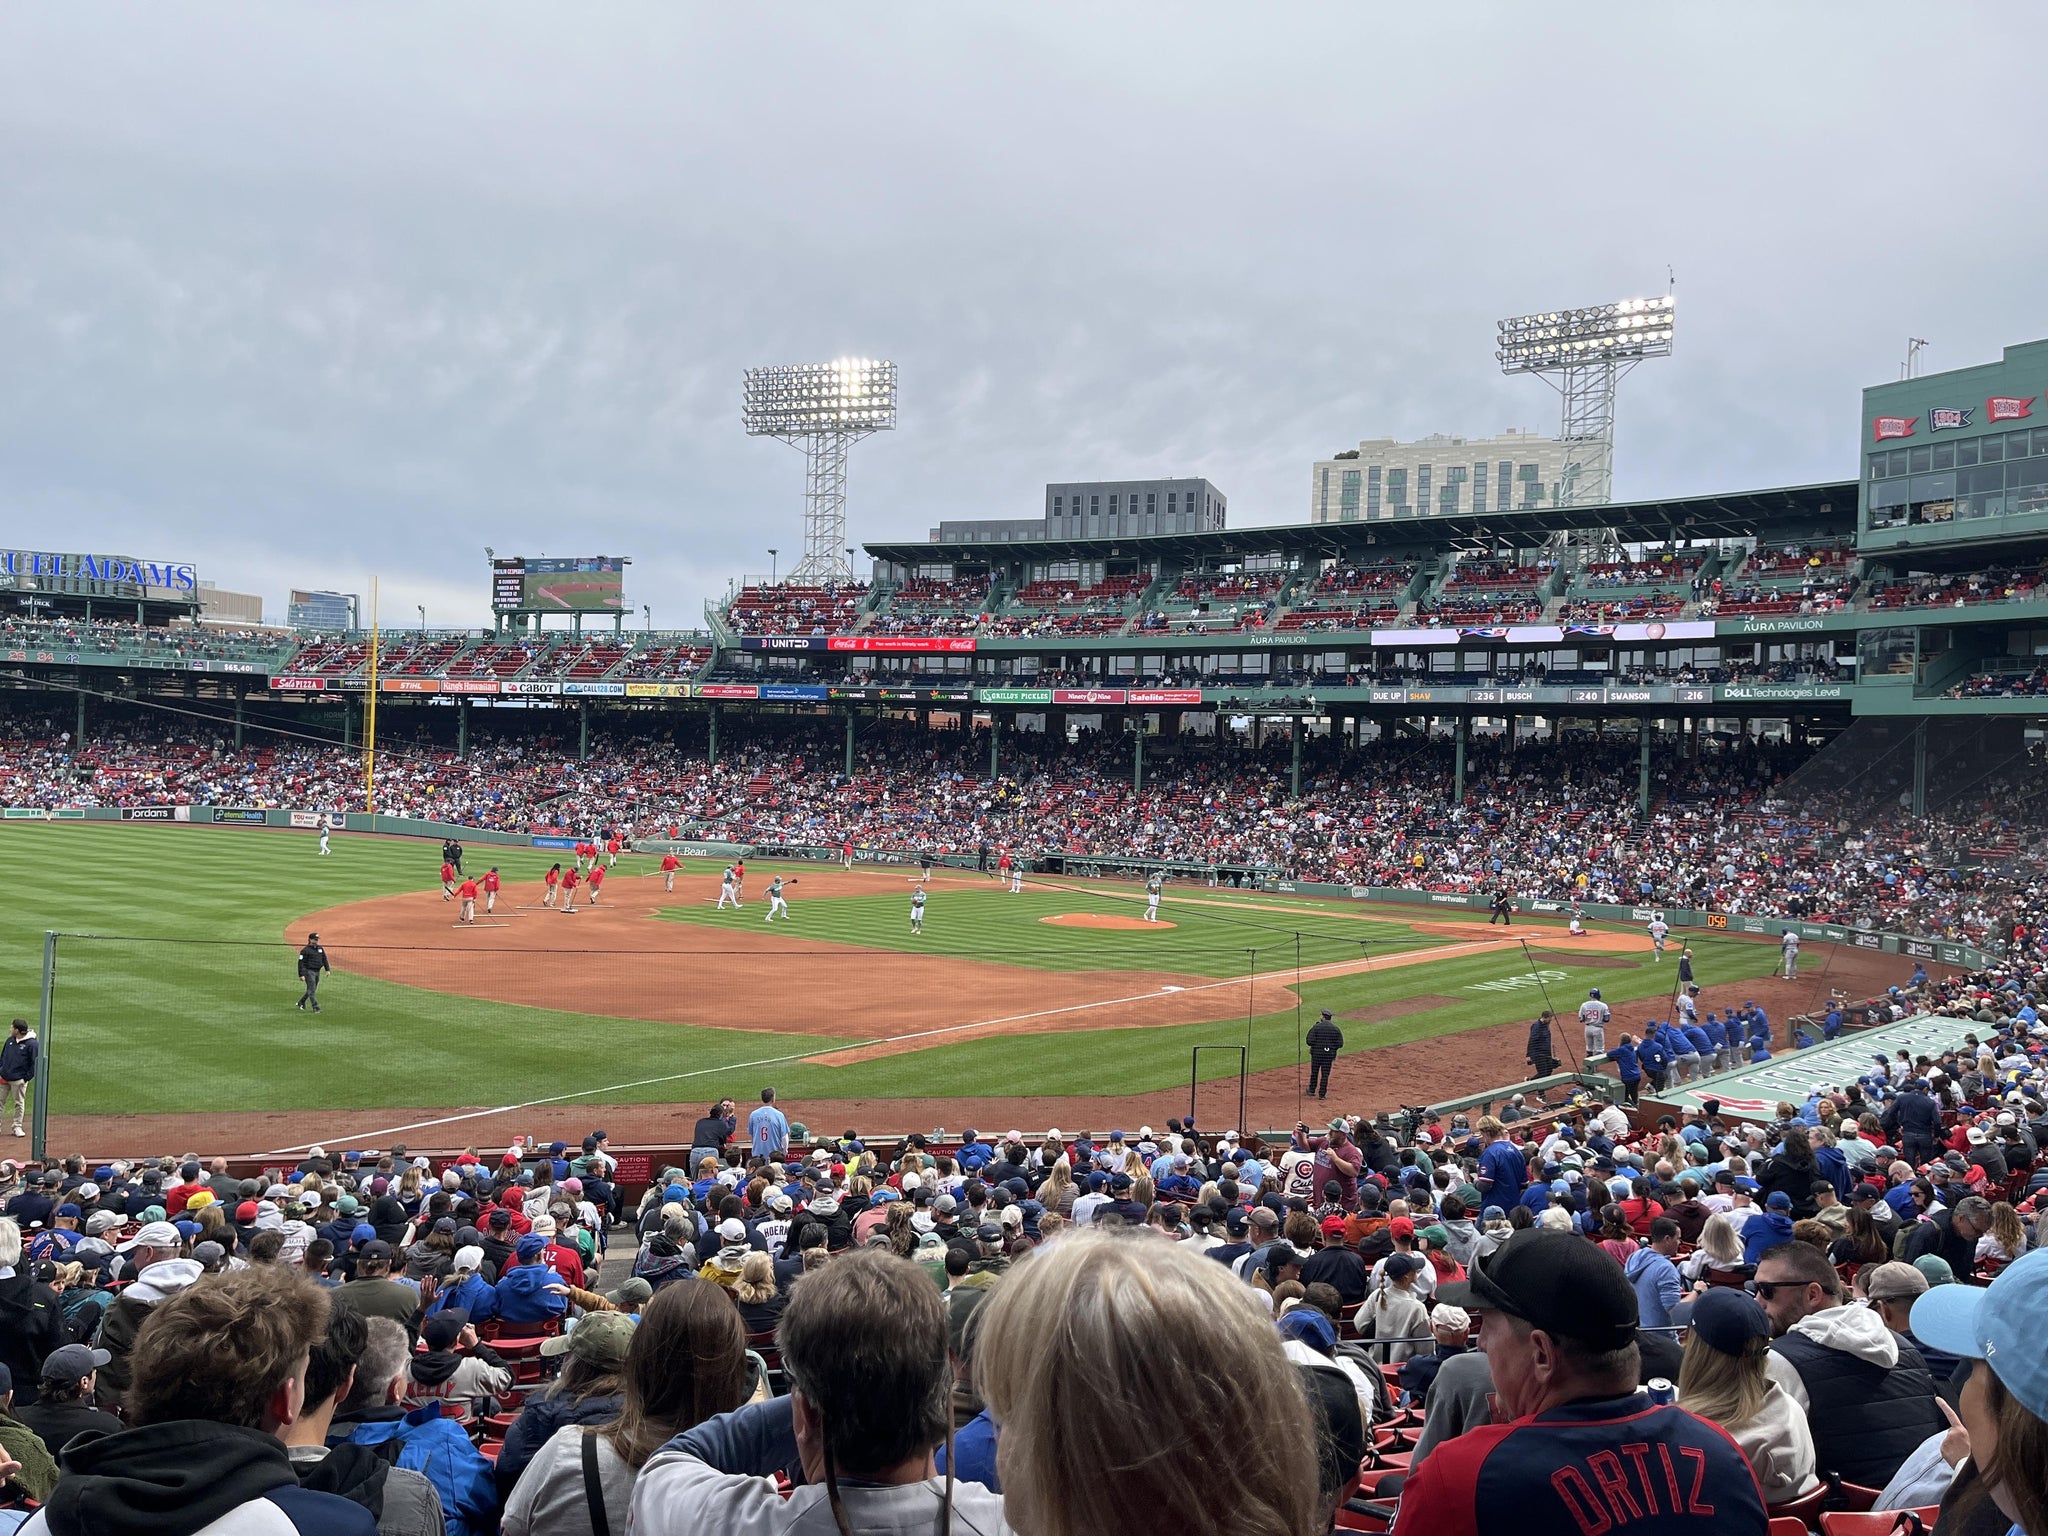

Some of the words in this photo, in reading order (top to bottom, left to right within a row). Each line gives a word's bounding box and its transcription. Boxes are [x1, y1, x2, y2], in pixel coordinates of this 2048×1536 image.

[0, 552, 71, 577] UEL
[75, 553, 194, 591] ADAMS
[1778, 620, 1823, 630] PAVILION
[772, 639, 809, 648] UNITED
[834, 639, 856, 648] Coca-Cola
[950, 640, 972, 649] Coca-Cola
[36, 652, 54, 662] 34
[65, 654, 80, 664] 42
[296, 680, 317, 689] PIZZA
[443, 682, 462, 692] King's
[464, 682, 497, 691] Hawaiian
[520, 683, 554, 693] CABOT
[583, 684, 623, 693] CALL128.COM
[1474, 692, 1494, 700] .236
[1506, 692, 1532, 700] BUSCH
[1576, 692, 1598, 700] .240
[1611, 692, 1650, 700] SWANSON
[1684, 692, 1703, 700] .216
[1815, 688, 1840, 697] Level
[1432, 894, 1467, 904] smartwater
[1864, 935, 1879, 944] MGM
[1916, 944, 1932, 953] MGM
[1585, 1010, 1599, 1020] 29
[1735, 1041, 1899, 1096] FENWAY
[1872, 1019, 1986, 1050] PARK
[761, 1127, 768, 1141] 6
[1291, 1180, 1313, 1188] Cub
[764, 1226, 789, 1237] HOERN
[407, 1380, 456, 1398] KELLY
[1551, 1442, 1714, 1536] ORTIZ
